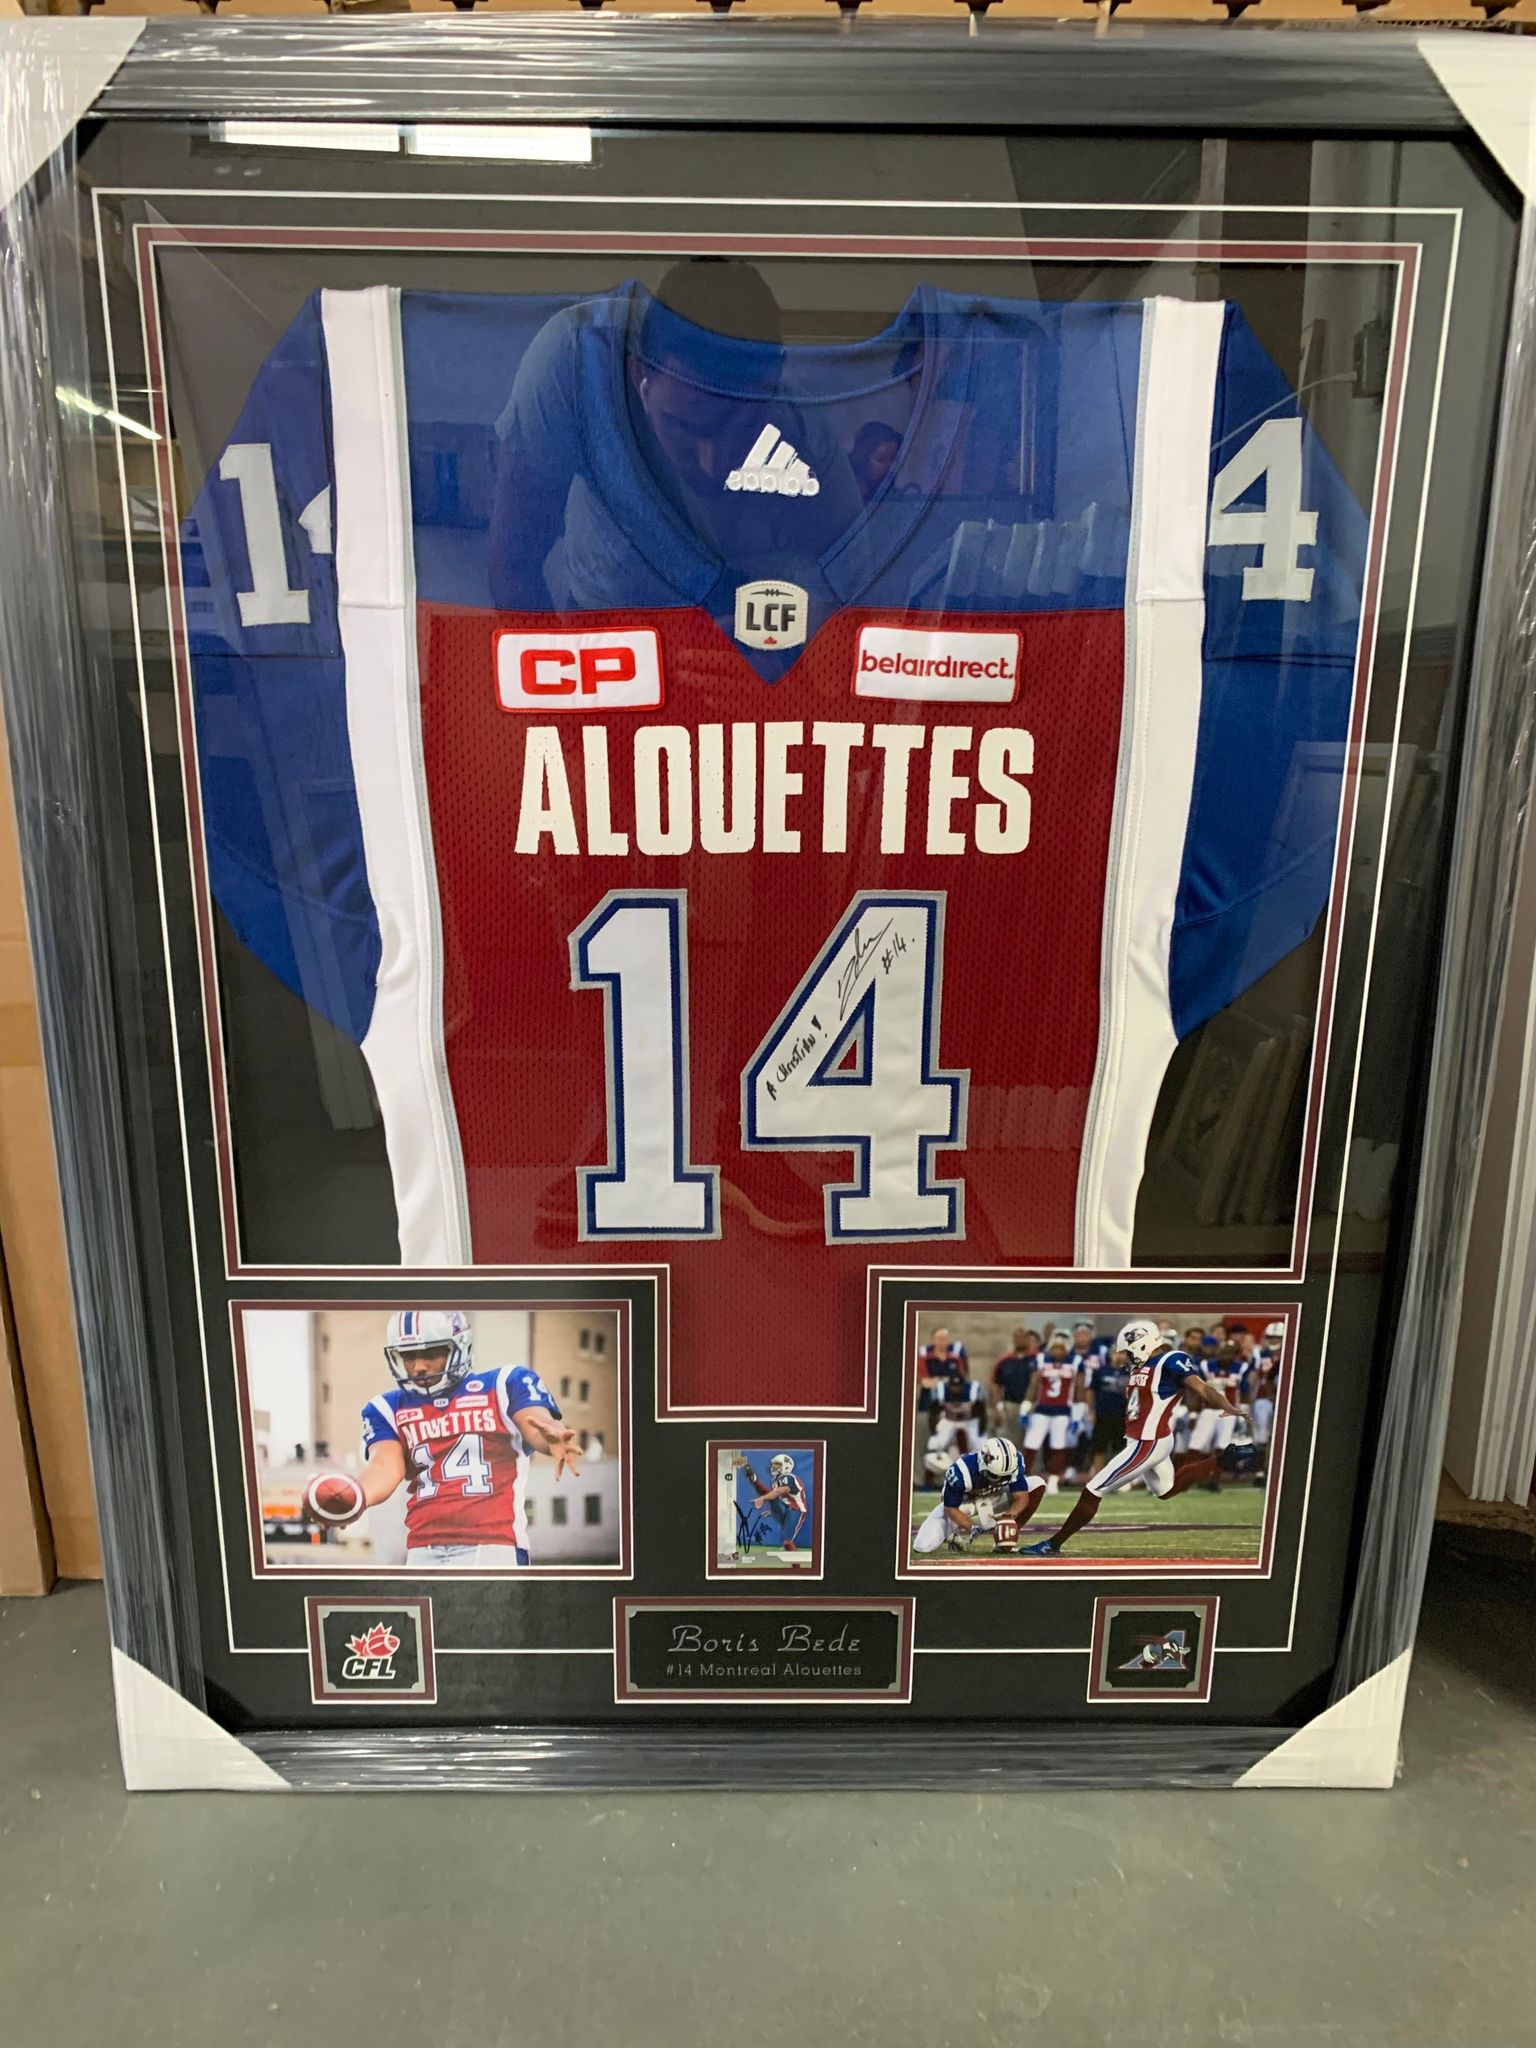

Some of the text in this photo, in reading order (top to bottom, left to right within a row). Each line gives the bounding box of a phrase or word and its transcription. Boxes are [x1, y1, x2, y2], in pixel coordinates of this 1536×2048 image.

[745, 602, 796, 632] LCF
[520, 648, 636, 695] CP
[514, 721, 1035, 856] ALOUETTES
[568, 888, 971, 1246] 14
[668, 1623, 861, 1652] Boris Bede
[341, 1656, 397, 1680] CFL
[666, 1663, 862, 1676] #14 Montreal Alouettes
